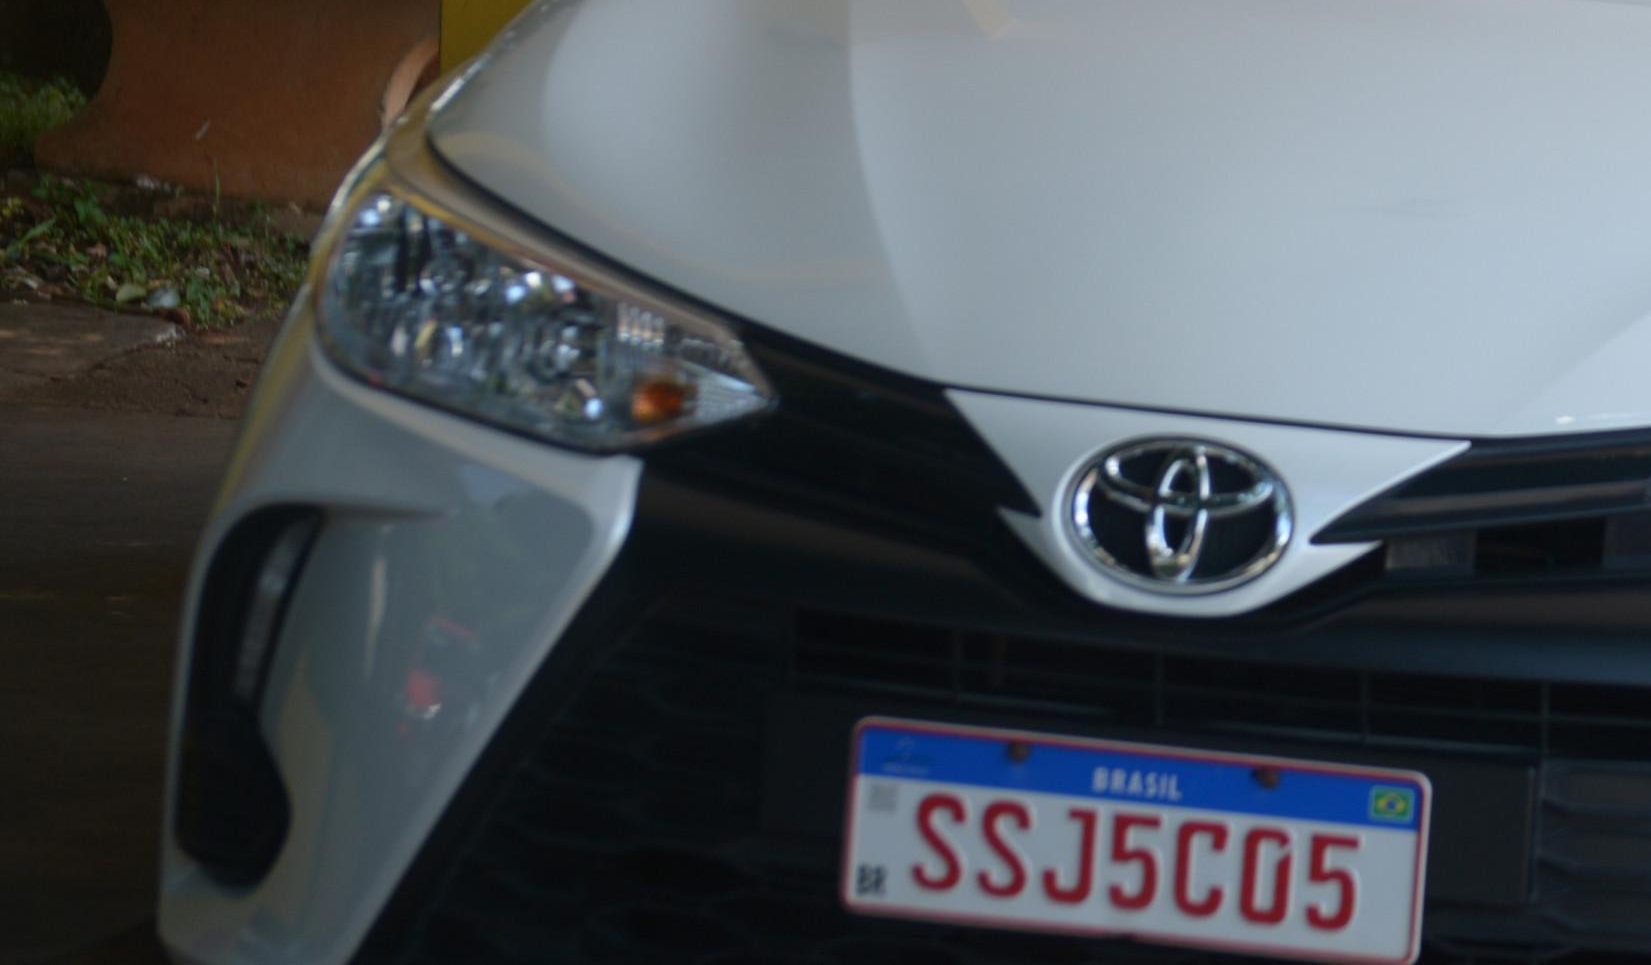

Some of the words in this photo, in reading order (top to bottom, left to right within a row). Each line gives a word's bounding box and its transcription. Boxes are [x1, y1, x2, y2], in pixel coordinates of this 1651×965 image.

[1092, 766, 1183, 801] BRASIL
[911, 792, 1362, 932] SSJ5C05
[856, 864, 887, 896] BR
